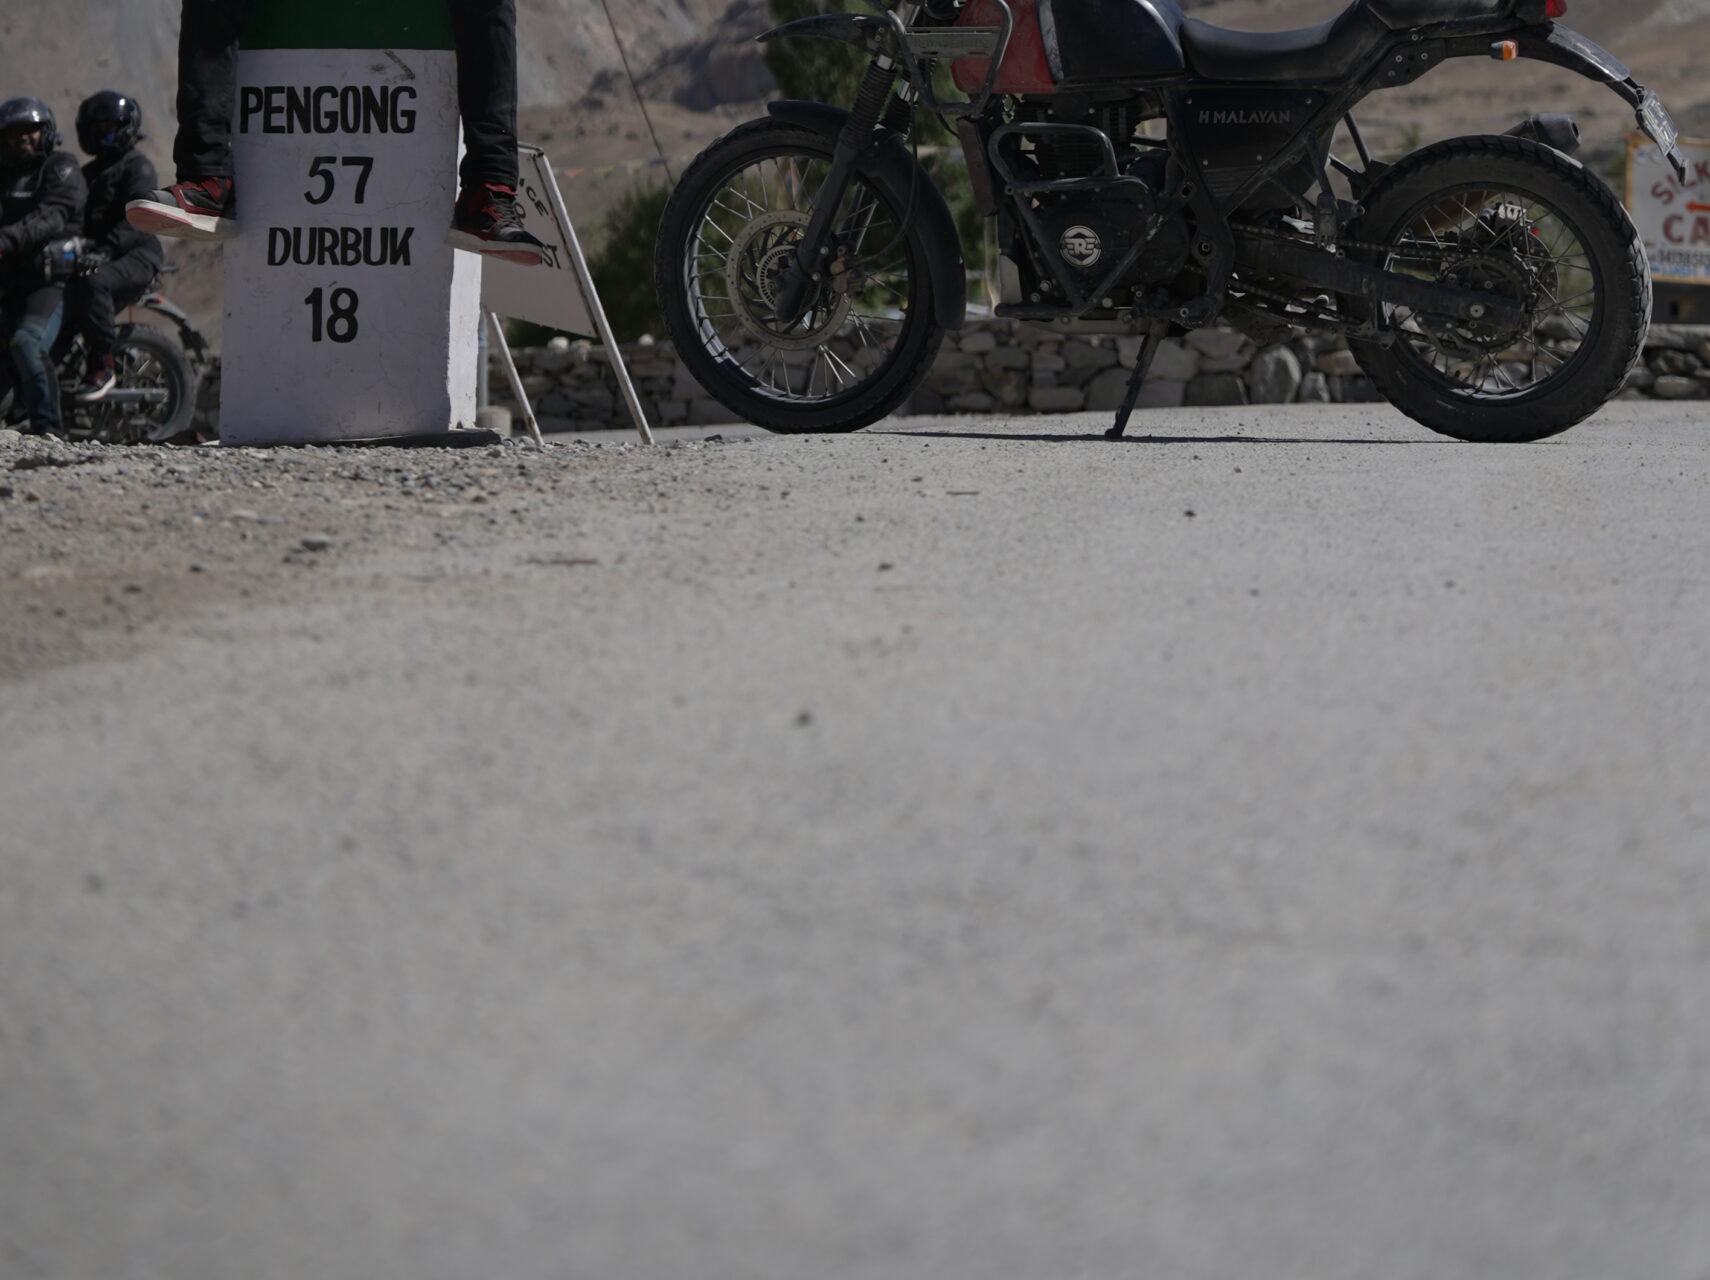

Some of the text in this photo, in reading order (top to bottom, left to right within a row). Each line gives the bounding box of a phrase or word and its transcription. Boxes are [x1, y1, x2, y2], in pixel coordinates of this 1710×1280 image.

[239, 85, 418, 134] PENGONG
[303, 156, 374, 205] 57
[267, 226, 415, 267] DURBUK
[303, 287, 360, 343] 18
